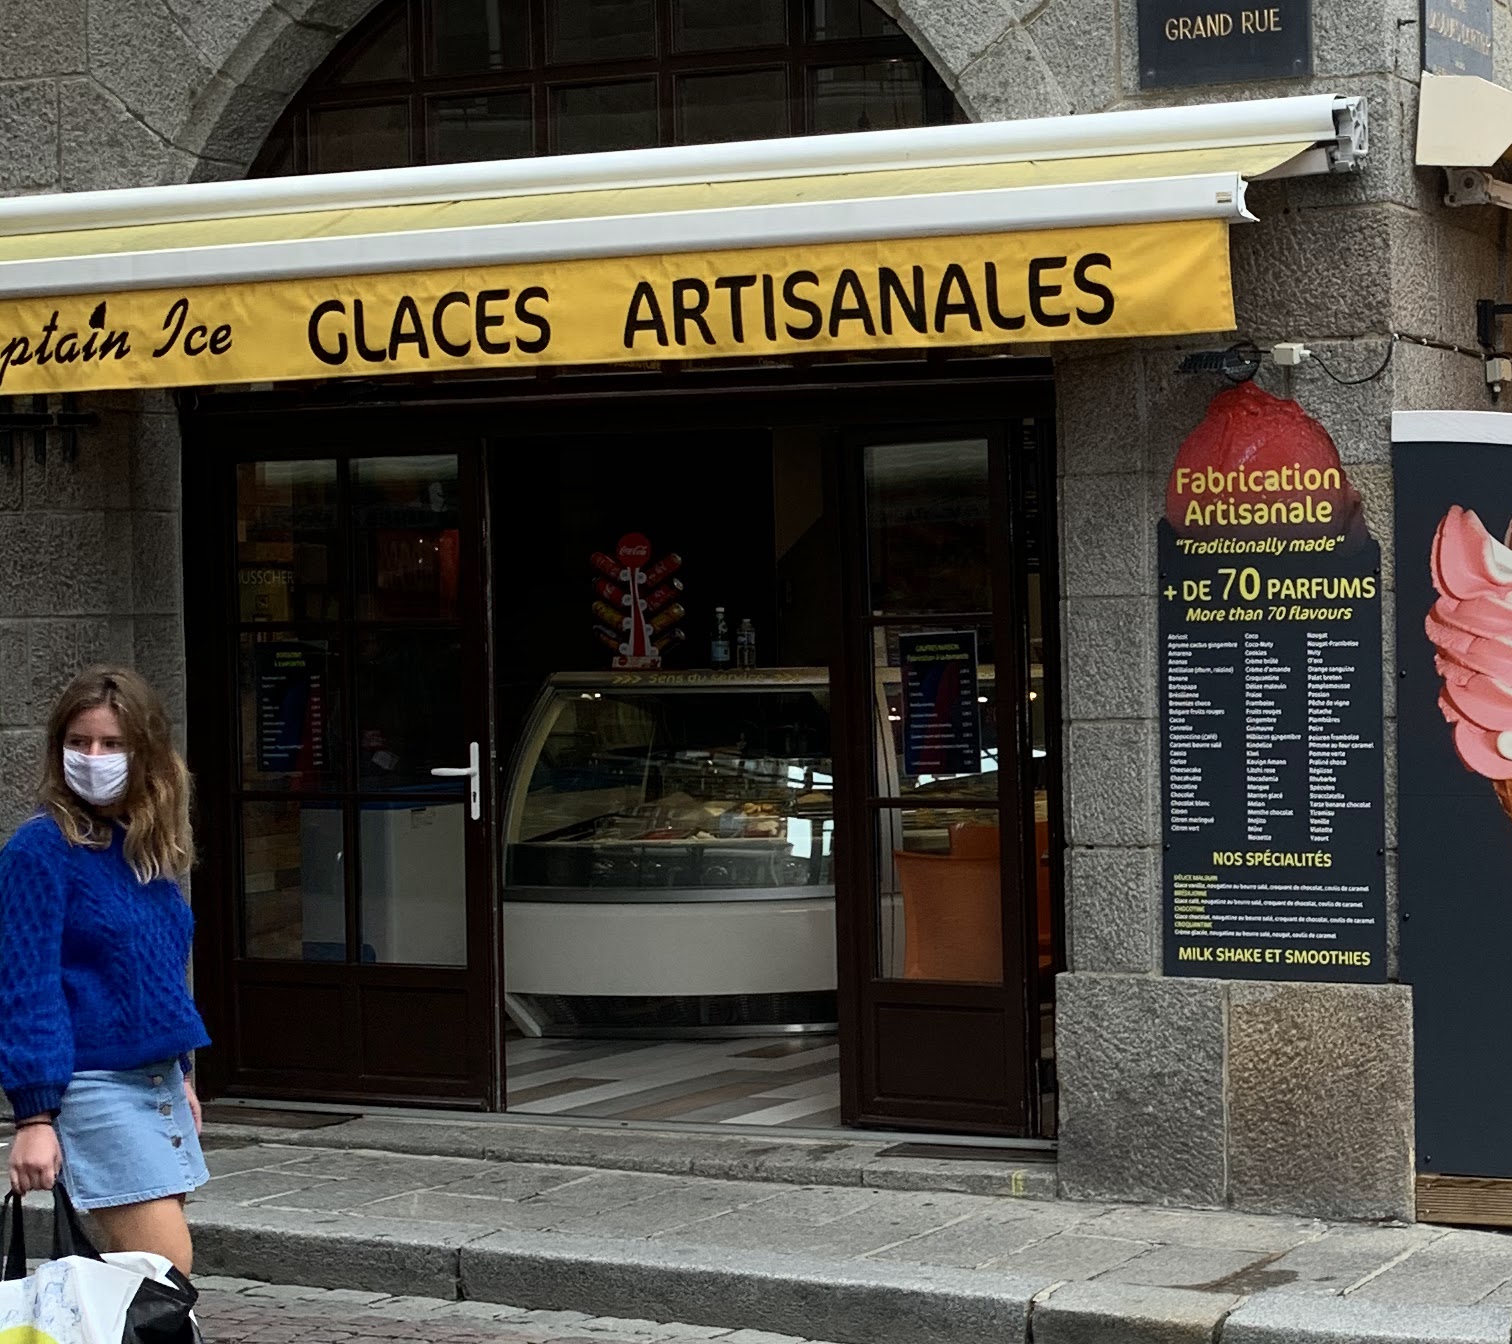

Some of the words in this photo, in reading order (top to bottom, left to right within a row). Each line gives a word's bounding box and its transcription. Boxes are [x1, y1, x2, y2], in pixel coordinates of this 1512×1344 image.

[1166, 14, 1232, 40] GRAND
[1242, 9, 1281, 33] RUE
[153, 298, 232, 357] Ice
[308, 287, 550, 365] GLACES
[623, 252, 1115, 348] ARTISANALES
[1177, 463, 1340, 494] Fabrication
[1185, 494, 1332, 525] Artisanale
[1183, 580, 1211, 601] DE
[1218, 567, 1260, 600] 70
[1268, 577, 1375, 599] PARFUMS
[1186, 608, 1225, 621] More
[1229, 607, 1263, 621] than
[1268, 607, 1286, 620] 70
[1289, 606, 1352, 620] flavours
[1213, 852, 1242, 865] NOS
[1246, 849, 1331, 867] SPÉCIALITÉS
[1179, 947, 1213, 960] MILK
[1216, 948, 1262, 962] SHAKE
[1265, 949, 1282, 962] ET
[1285, 950, 1370, 965] SMOOTHIES
